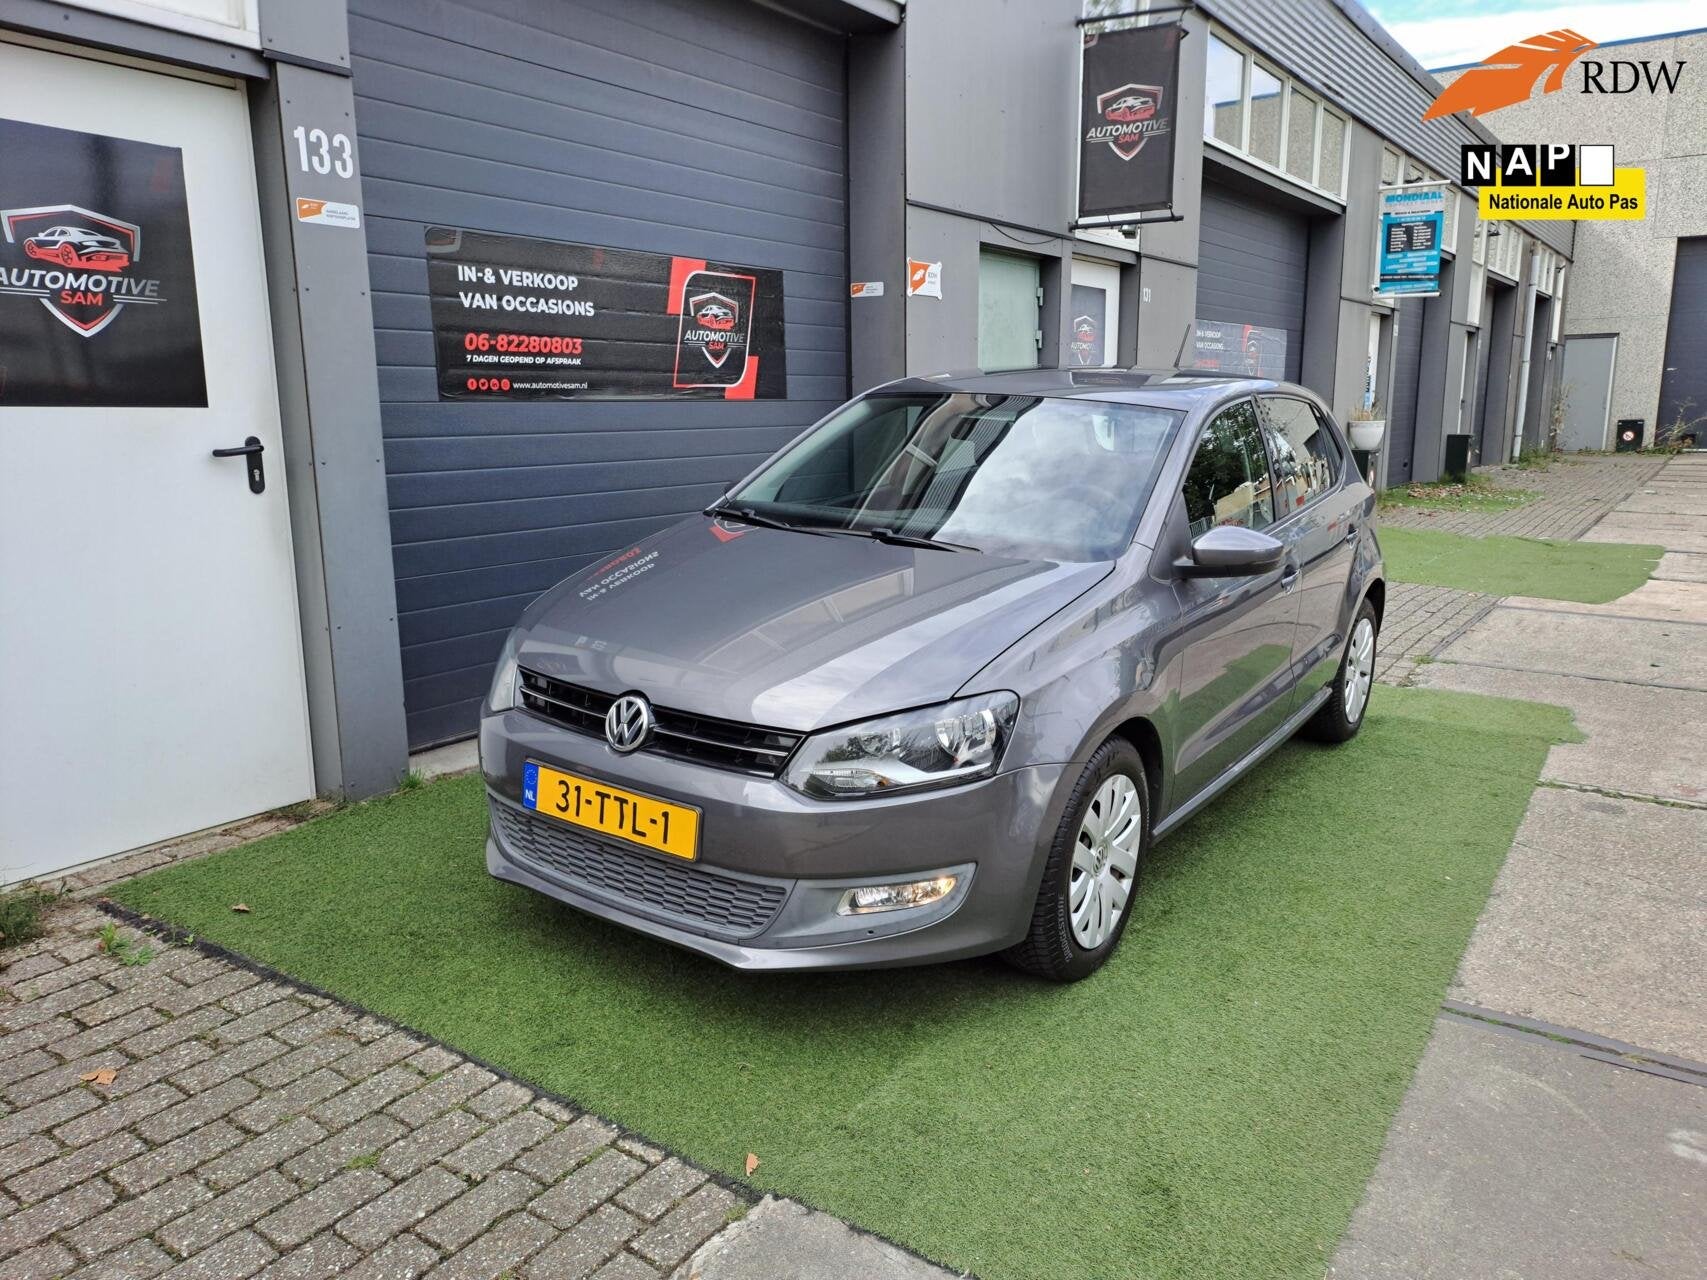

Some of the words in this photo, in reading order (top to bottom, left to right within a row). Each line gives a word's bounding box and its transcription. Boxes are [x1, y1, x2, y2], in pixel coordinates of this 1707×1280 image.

[1086, 117, 1168, 139] AUTOMOTIVE
[1117, 133, 1140, 143] SAM
[293, 126, 353, 178] 133
[0, 266, 161, 297] AUTOMOTIVE
[499, 269, 579, 291] VERKOOP
[60, 290, 103, 306] SAM
[459, 291, 498, 310] VAN
[501, 295, 595, 317] OCCASIONS
[464, 332, 583, 354] 06-82280803
[684, 330, 745, 343] AUTOMOTIVE
[708, 341, 725, 350] SAM
[466, 354, 472, 363] 7
[472, 354, 499, 363] DAGEN
[500, 356, 534, 364] GEOPEND
[535, 356, 546, 365] OP
[546, 357, 582, 366] AFSPRAAK
[512, 380, 588, 390] www.automotivesam.nl
[525, 789, 535, 801] NL
[556, 780, 670, 845] 31-TTL-1
